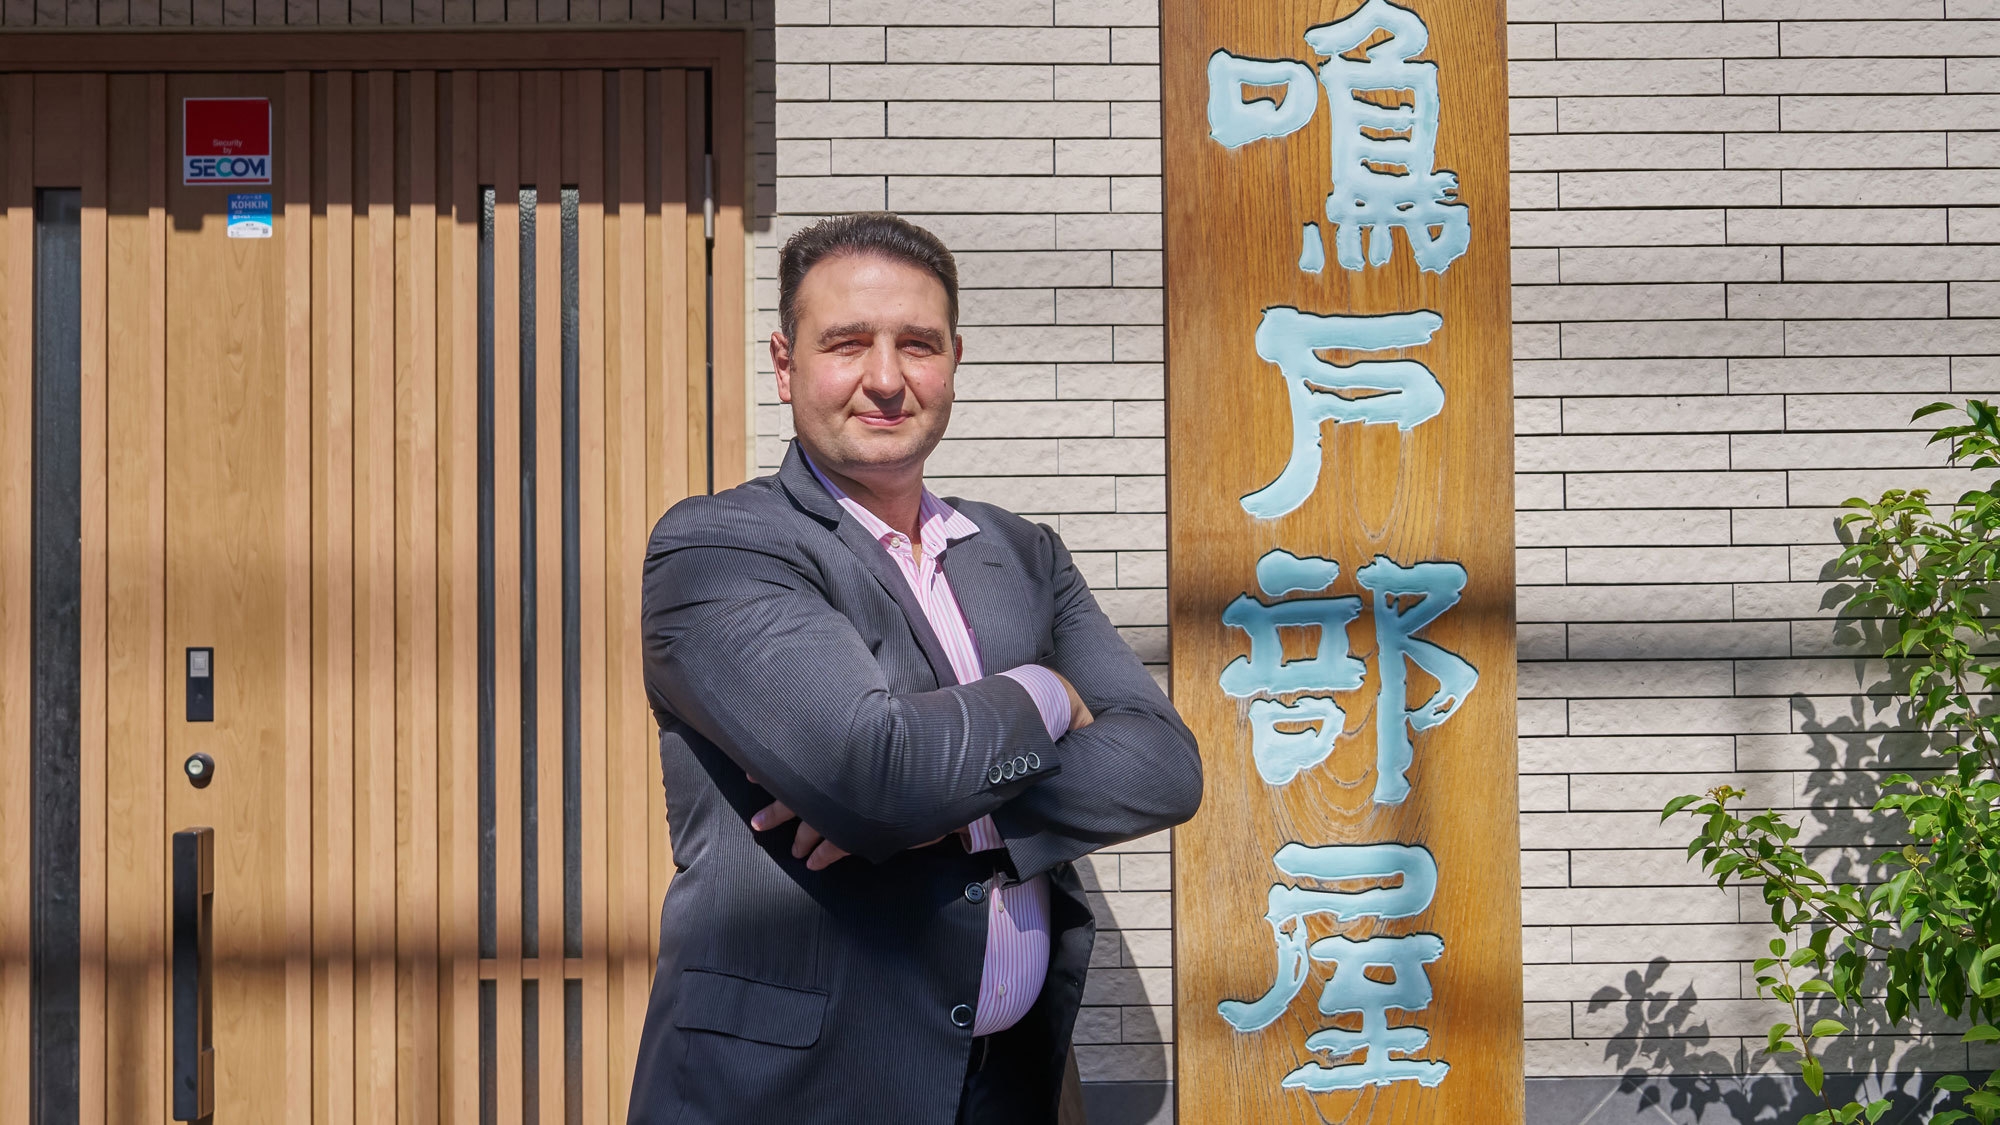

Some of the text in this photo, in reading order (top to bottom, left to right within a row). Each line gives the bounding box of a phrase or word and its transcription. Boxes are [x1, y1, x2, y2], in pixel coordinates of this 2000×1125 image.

[213, 139, 243, 148] Security
[189, 157, 266, 177] SECOM
[231, 200, 268, 209] KOHKIN
